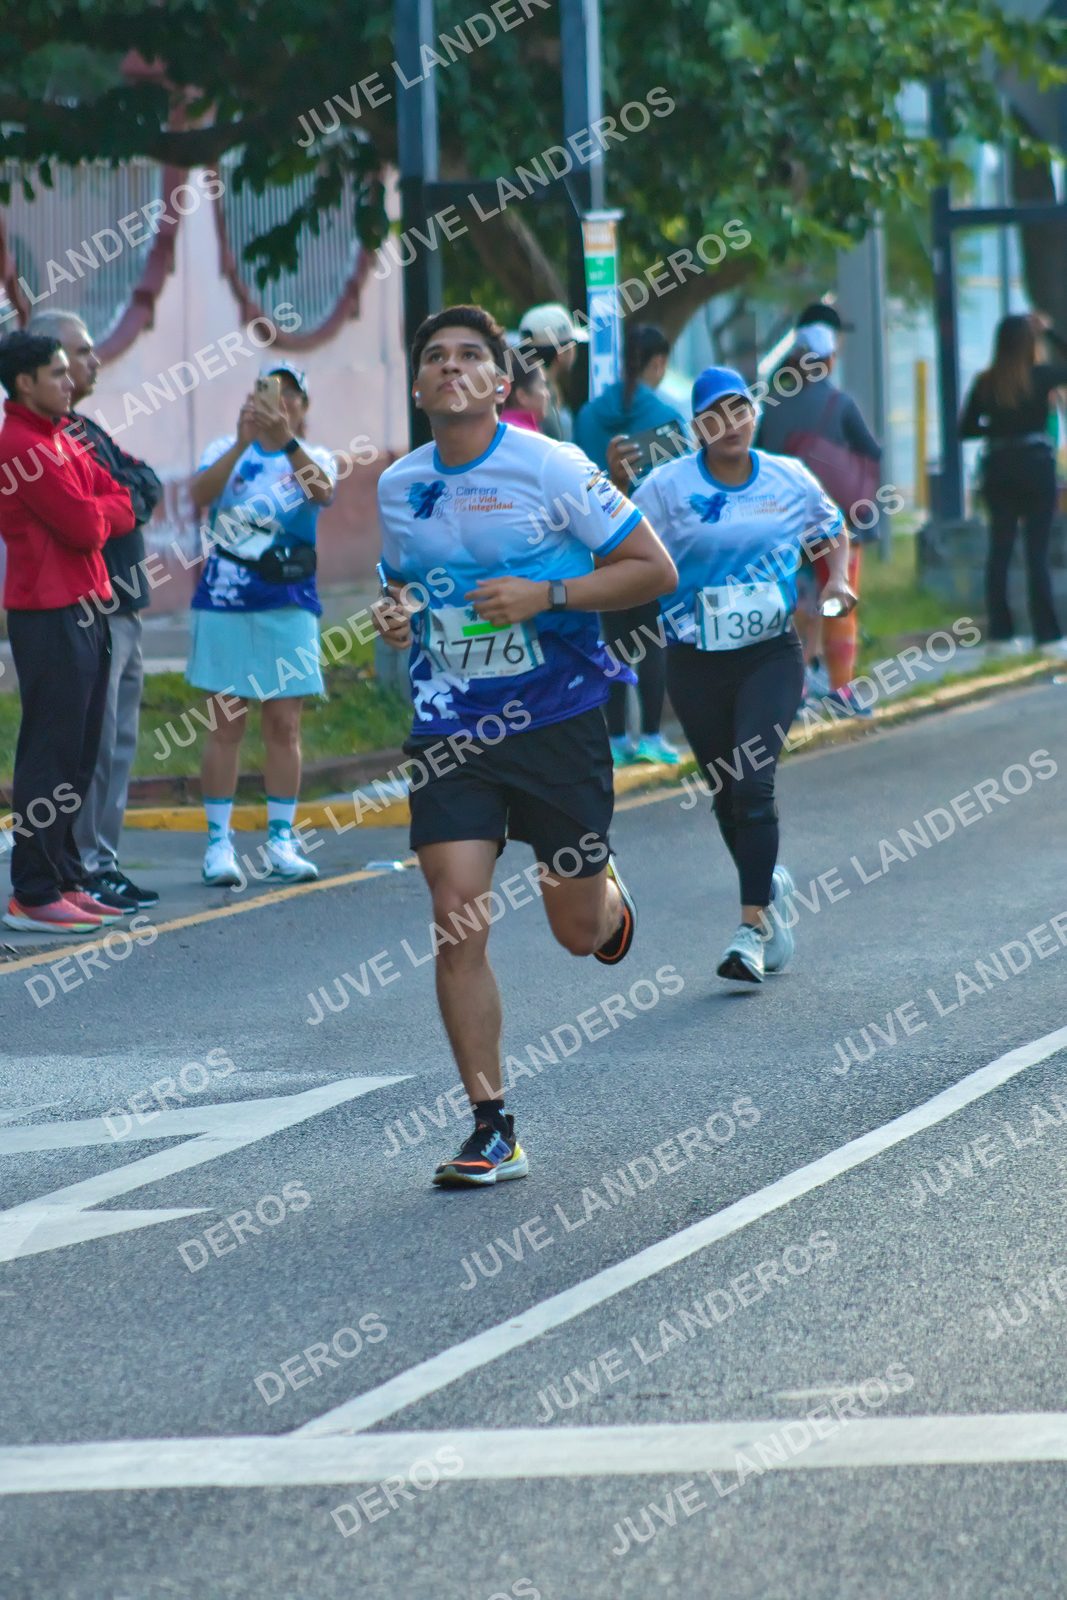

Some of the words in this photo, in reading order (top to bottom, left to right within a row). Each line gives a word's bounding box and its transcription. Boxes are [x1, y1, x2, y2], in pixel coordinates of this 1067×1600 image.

[455, 486, 498, 496] Carrera
[468, 502, 513, 512] Integridad
[711, 608, 781, 641] 1384
[436, 632, 524, 669] 1776
